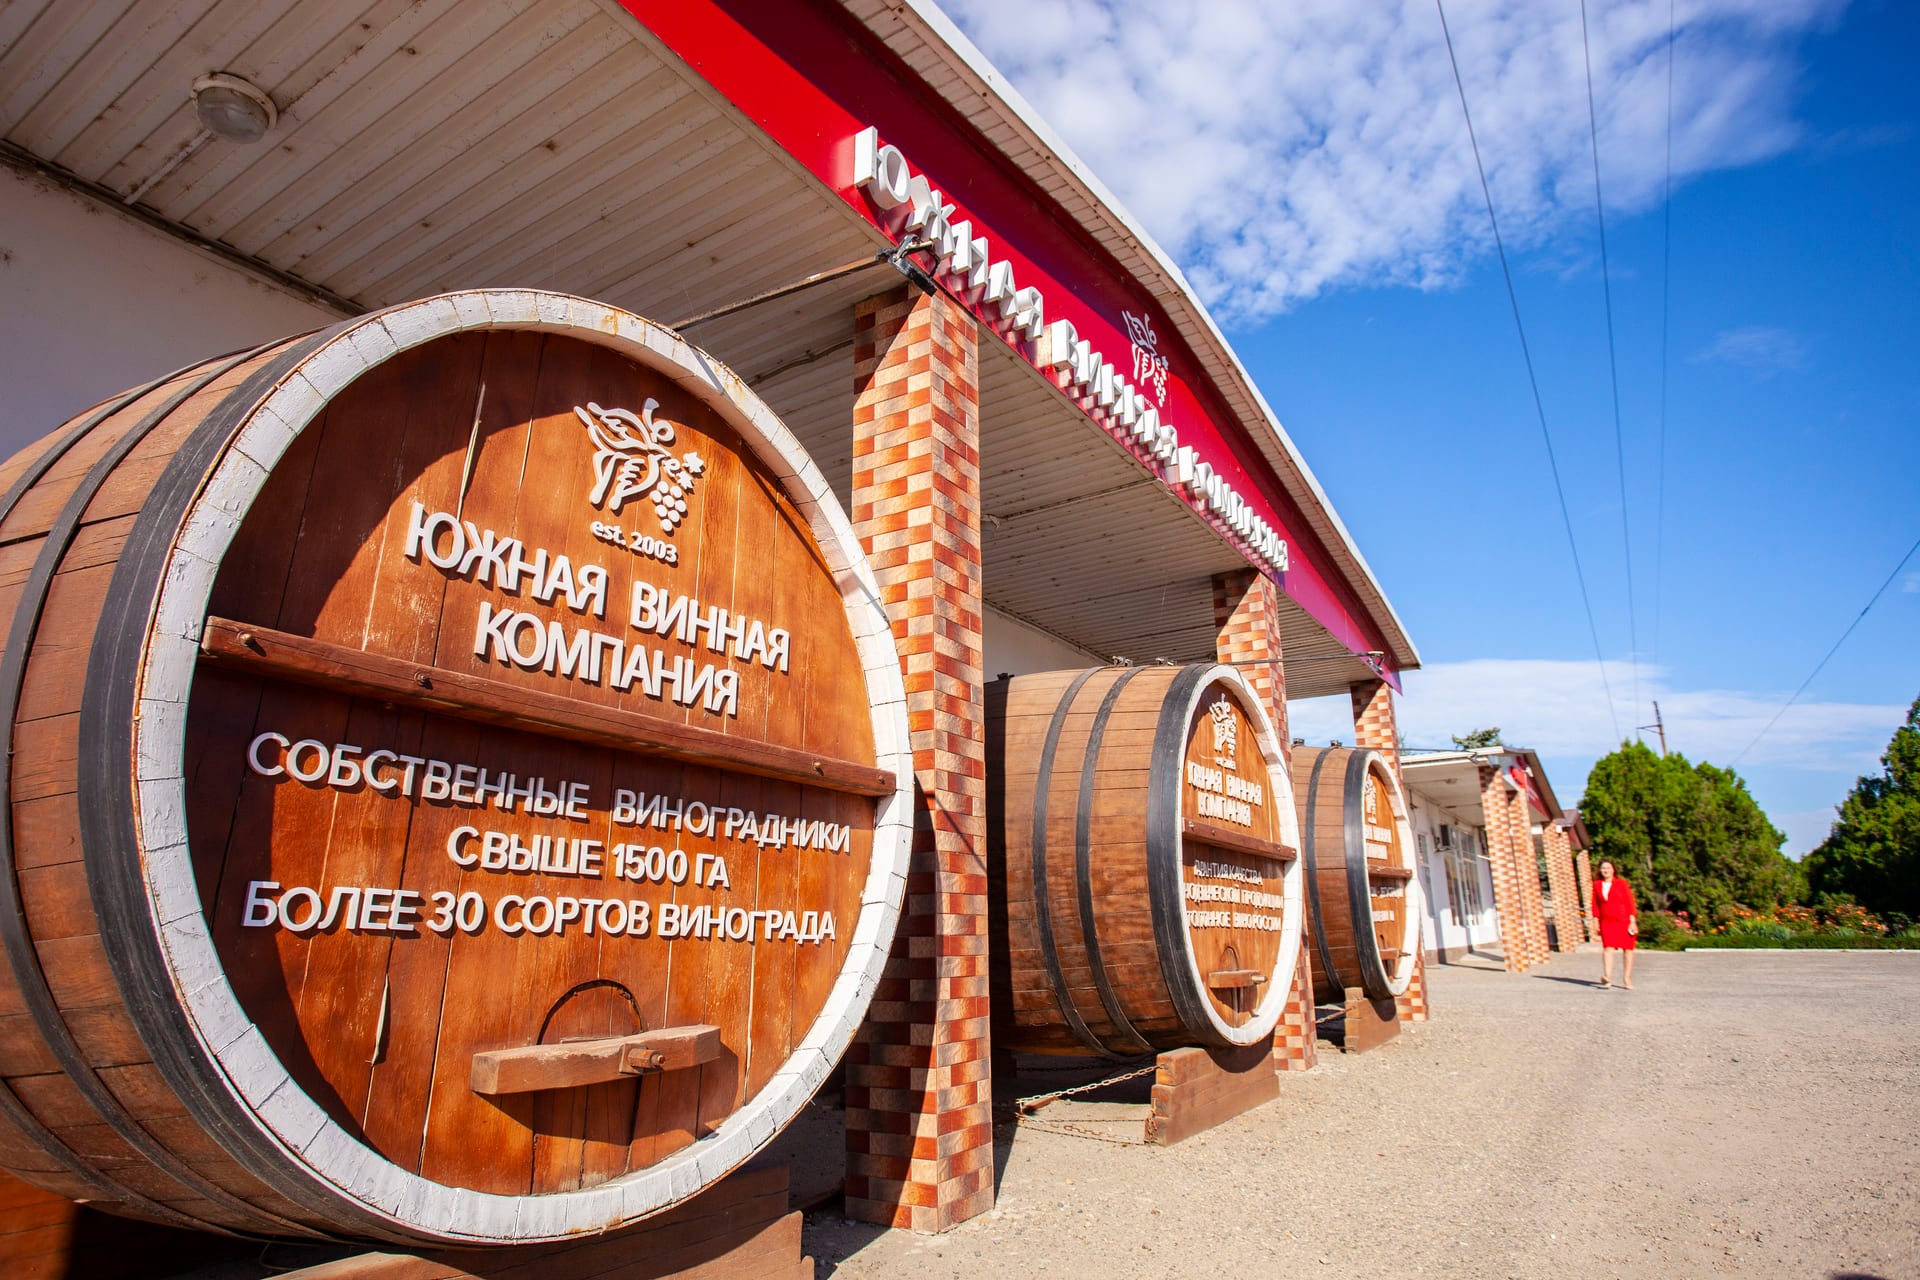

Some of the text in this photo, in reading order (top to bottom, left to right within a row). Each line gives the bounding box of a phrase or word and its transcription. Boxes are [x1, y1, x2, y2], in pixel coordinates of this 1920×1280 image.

[854, 126, 1289, 572] ЮЖНАЯ ВИННАЯ КОМПАНИЯ
[404, 501, 790, 672] ЮЖНАЯ ВИННАЯ
[590, 521, 678, 563] est. 2003
[473, 601, 738, 715] КОМПАНИЯ
[247, 732, 851, 853] СОБСТВЕННЫЕ ВИНОГРАДНИКИ
[240, 881, 836, 945] БОЛЕЕ 30 СОРТОВ ВИНОГРАДА
[447, 826, 730, 888] СВЫШЕ 1500 ГА
